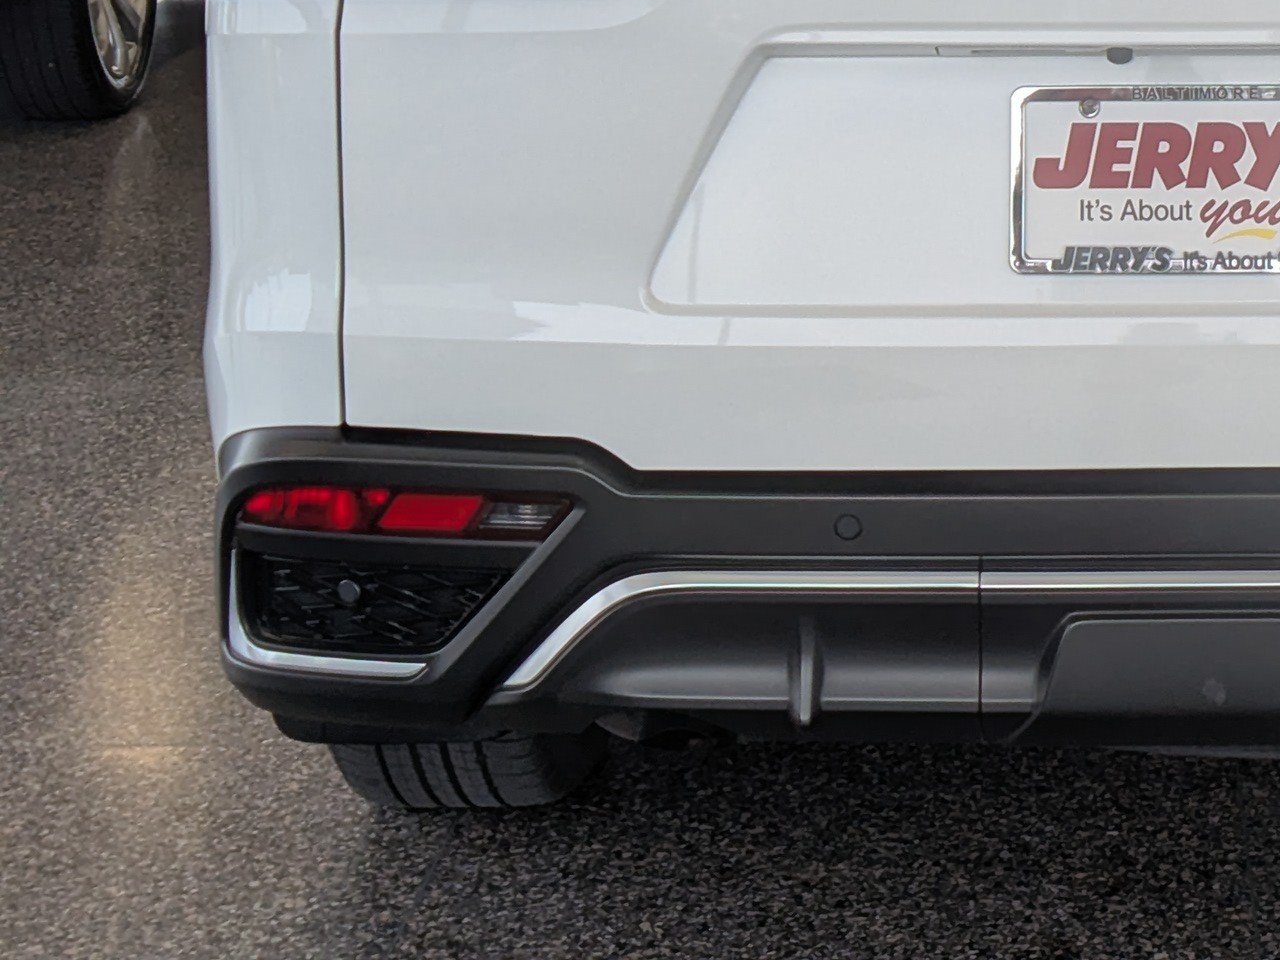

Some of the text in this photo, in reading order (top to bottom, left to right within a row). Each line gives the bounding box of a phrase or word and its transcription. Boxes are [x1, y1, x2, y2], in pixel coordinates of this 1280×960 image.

[1132, 85, 1260, 100] BALTIMORE
[1080, 199, 1112, 222] It's
[1121, 199, 1192, 222] About
[1051, 246, 1173, 272] JERRY'S
[1212, 250, 1274, 271] About
